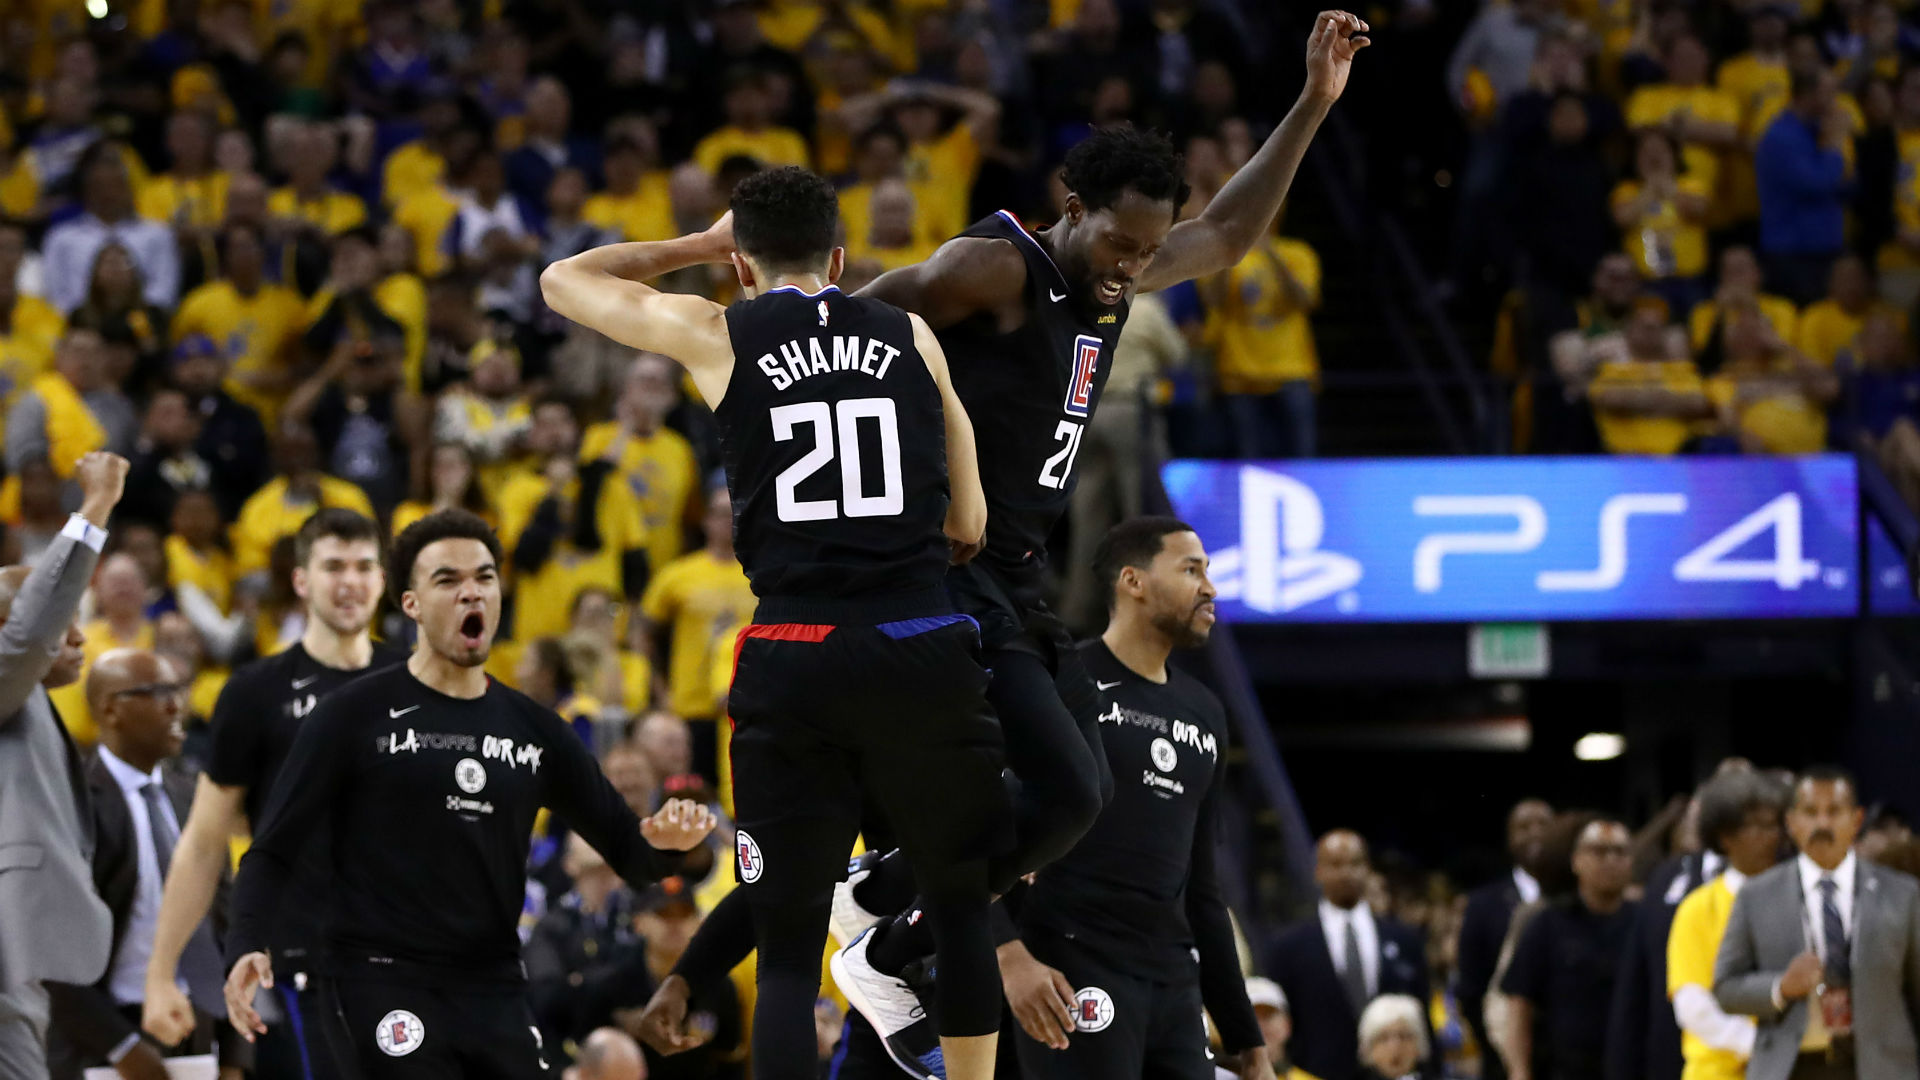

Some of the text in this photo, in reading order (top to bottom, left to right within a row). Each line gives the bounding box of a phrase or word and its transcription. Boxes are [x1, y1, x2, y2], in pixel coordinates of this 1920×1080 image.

[757, 335, 901, 391] SHAMET
[769, 398, 904, 523] 20
[1038, 420, 1085, 490] 21
[1412, 492, 1821, 594] PS4
[376, 727, 478, 755] PLAYOFFS
[482, 734, 516, 770] OUR
[1173, 719, 1204, 755] OUR
